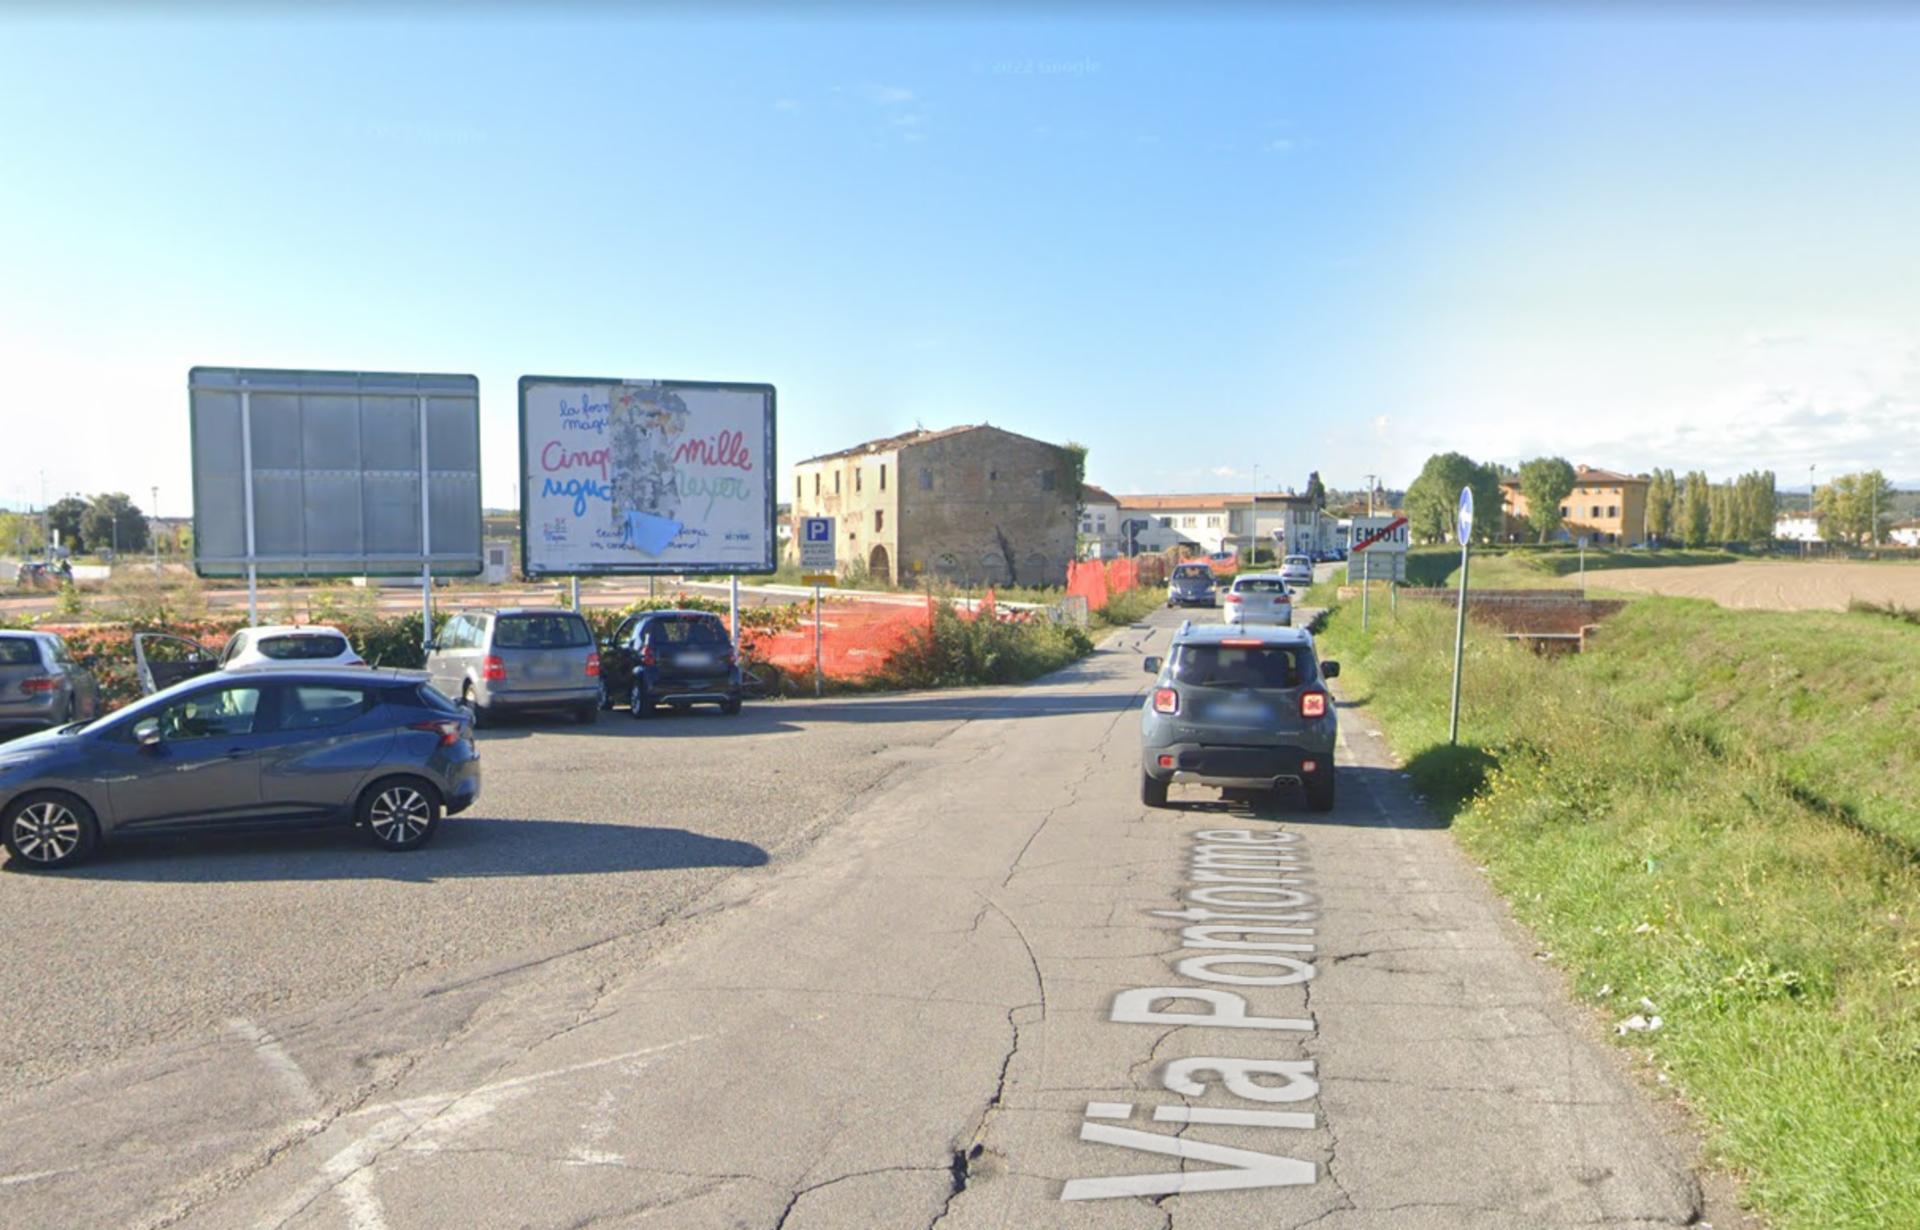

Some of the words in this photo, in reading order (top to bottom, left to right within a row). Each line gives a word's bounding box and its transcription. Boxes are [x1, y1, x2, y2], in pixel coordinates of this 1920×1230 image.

[559, 399, 580, 417] la
[541, 440, 610, 482] Cinq
[672, 429, 753, 471] mille
[811, 521, 826, 540] P
[1356, 527, 1405, 543] EMPOLI
